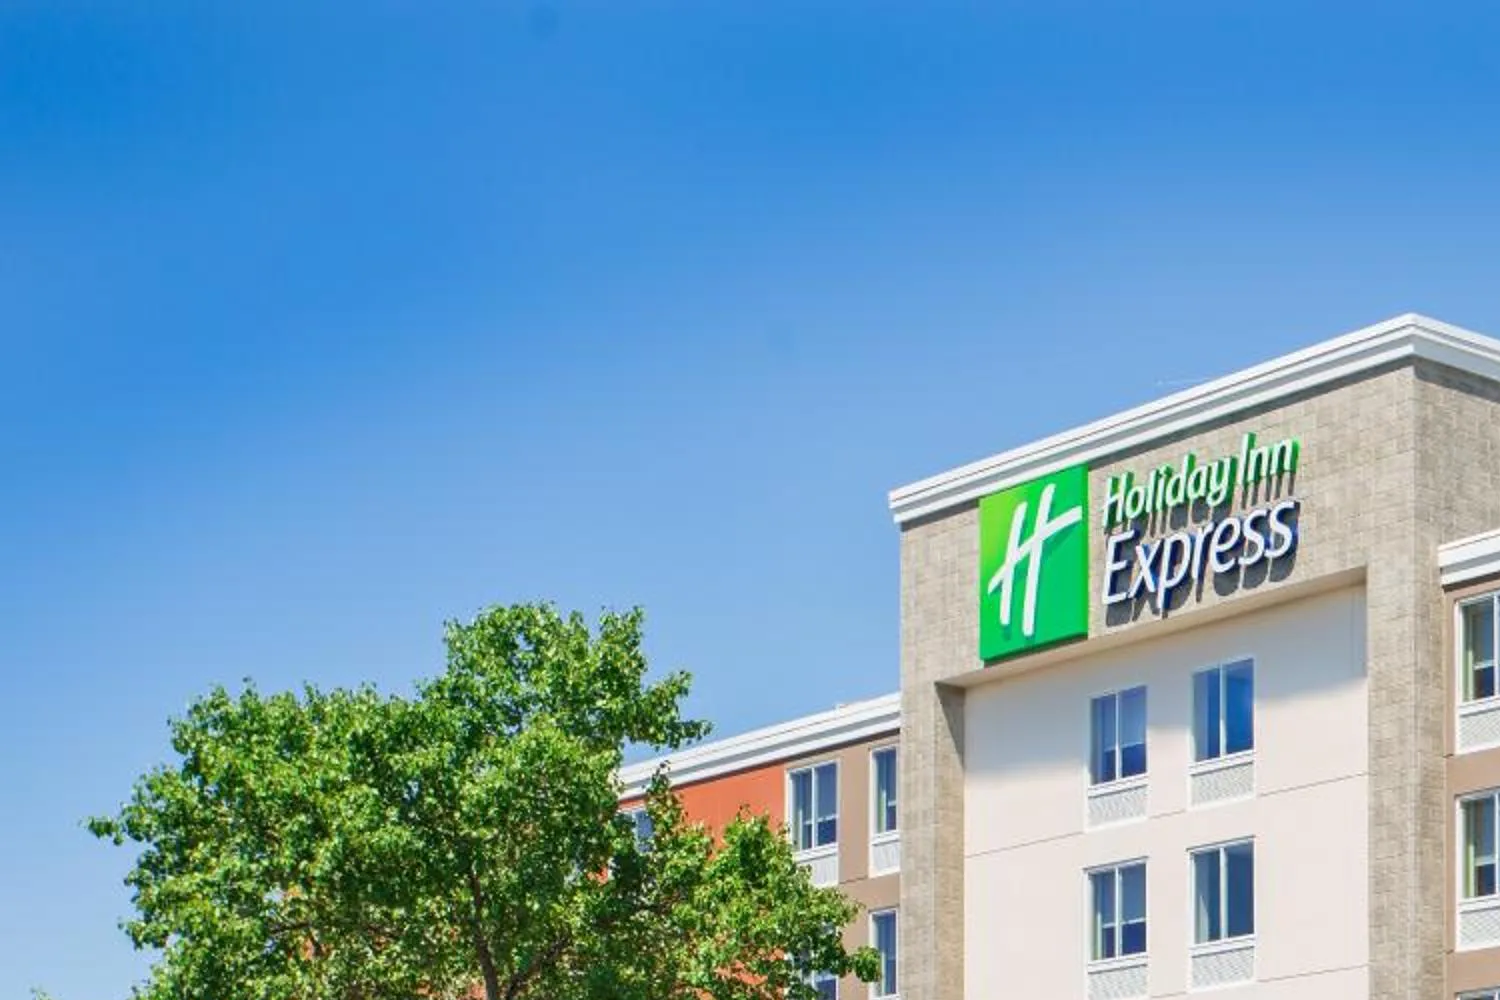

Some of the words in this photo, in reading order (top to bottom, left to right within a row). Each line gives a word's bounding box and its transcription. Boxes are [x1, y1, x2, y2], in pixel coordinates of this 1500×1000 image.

[1101, 453, 1235, 527] Holiday
[1239, 433, 1299, 485] Inn
[1103, 501, 1299, 610] Express
